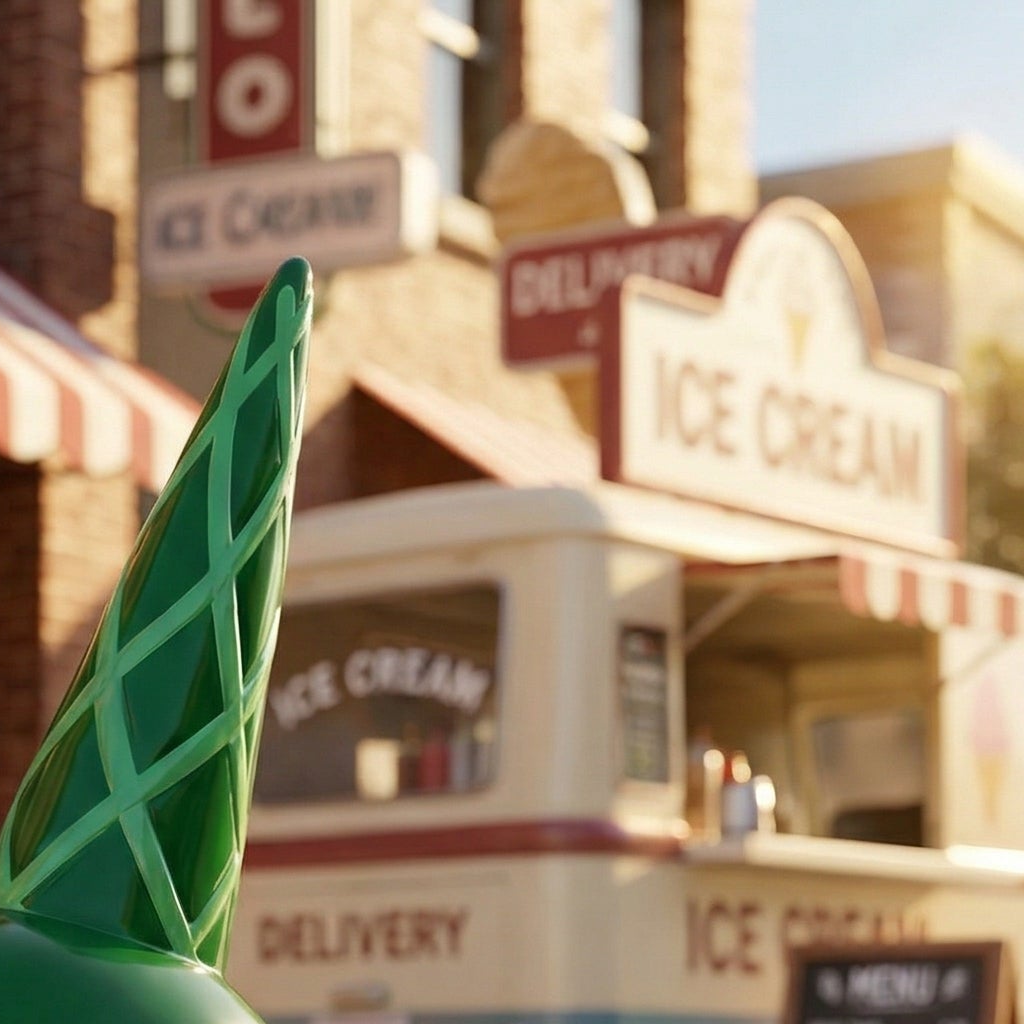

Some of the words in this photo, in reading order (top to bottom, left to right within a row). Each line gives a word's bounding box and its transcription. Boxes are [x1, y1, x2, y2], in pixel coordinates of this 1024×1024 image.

[656, 351, 737, 457] ICE
[757, 383, 922, 503] CREAM
[270, 660, 341, 731] ICE
[343, 646, 491, 716] CREAM
[257, 906, 472, 964] DELIVERY
[685, 898, 762, 977] ICE
[846, 963, 939, 1006] MENU
